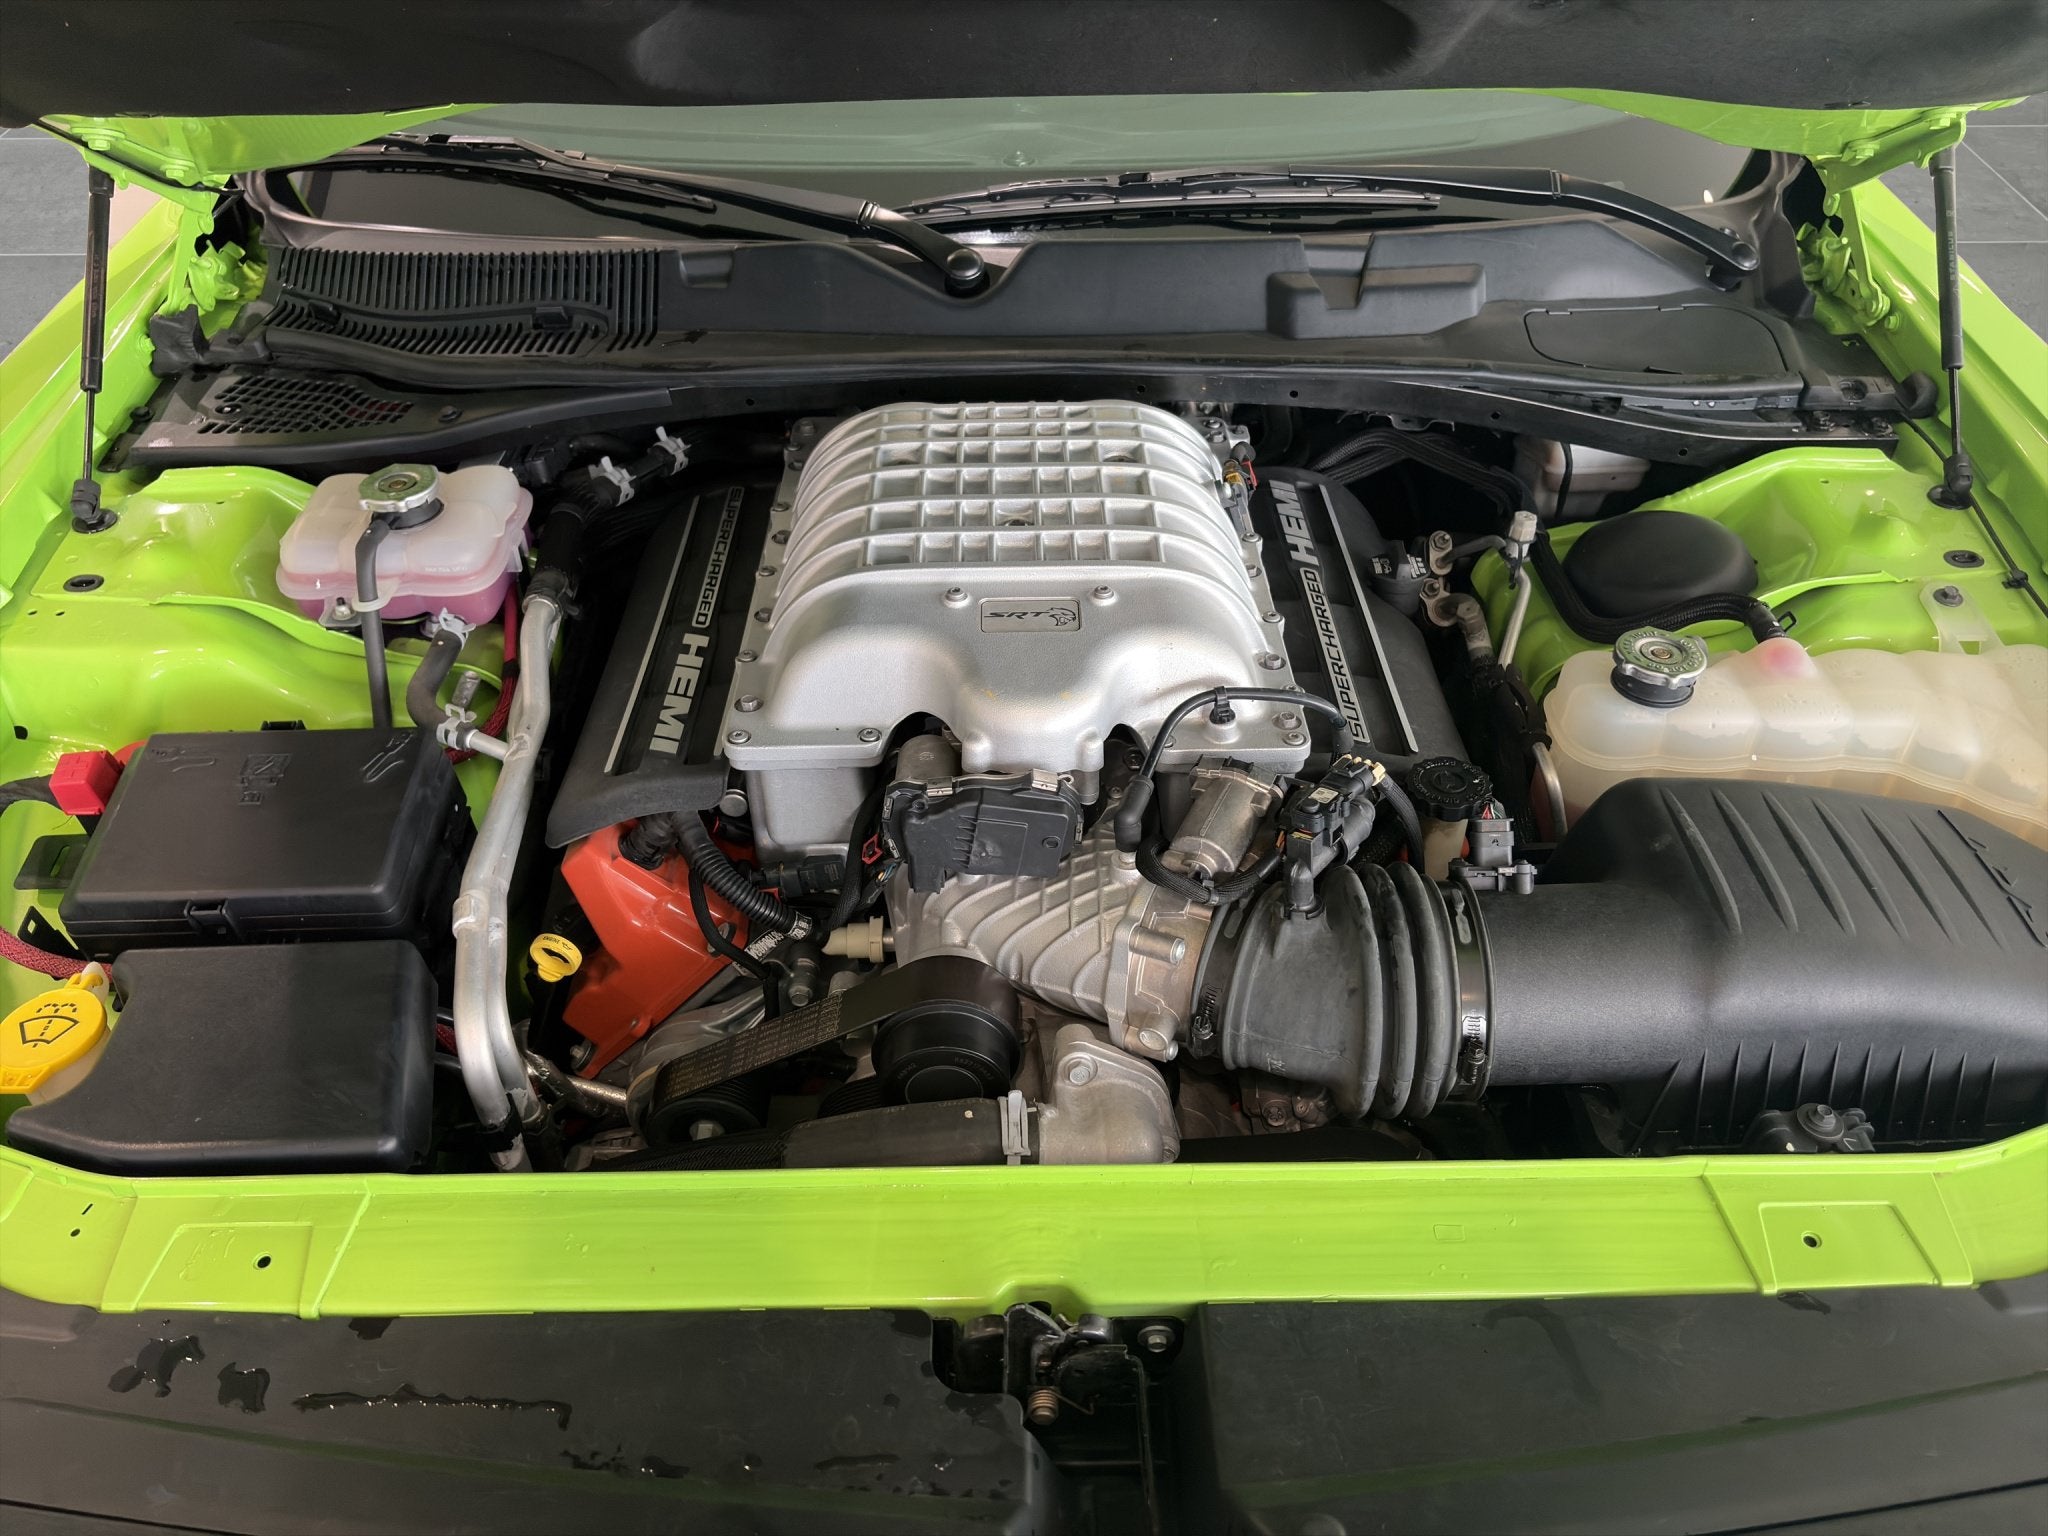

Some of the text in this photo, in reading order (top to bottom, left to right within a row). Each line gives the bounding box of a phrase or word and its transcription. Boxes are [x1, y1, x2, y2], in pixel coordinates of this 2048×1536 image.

[1269, 480, 1319, 566] HEMI
[649, 487, 744, 754] SUPERCHARGED HEMI
[984, 610, 1051, 620] SRT
[1302, 570, 1366, 740] SUPERCHARGED
